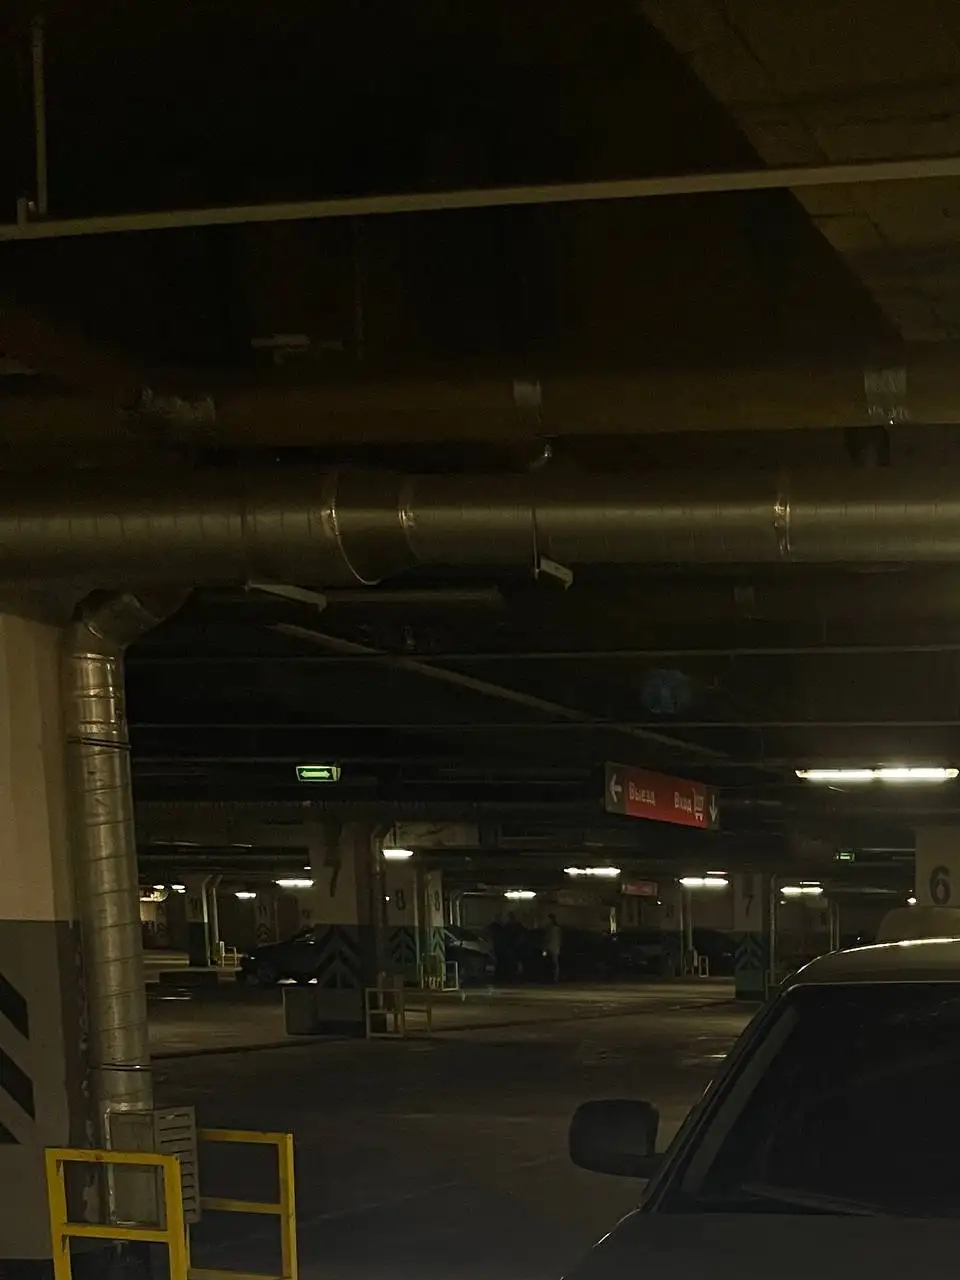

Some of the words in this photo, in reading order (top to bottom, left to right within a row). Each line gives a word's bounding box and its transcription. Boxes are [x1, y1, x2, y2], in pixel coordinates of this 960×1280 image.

[628, 781, 656, 806] Выезд
[674, 791, 693, 815] Вход
[929, 865, 951, 905] 6
